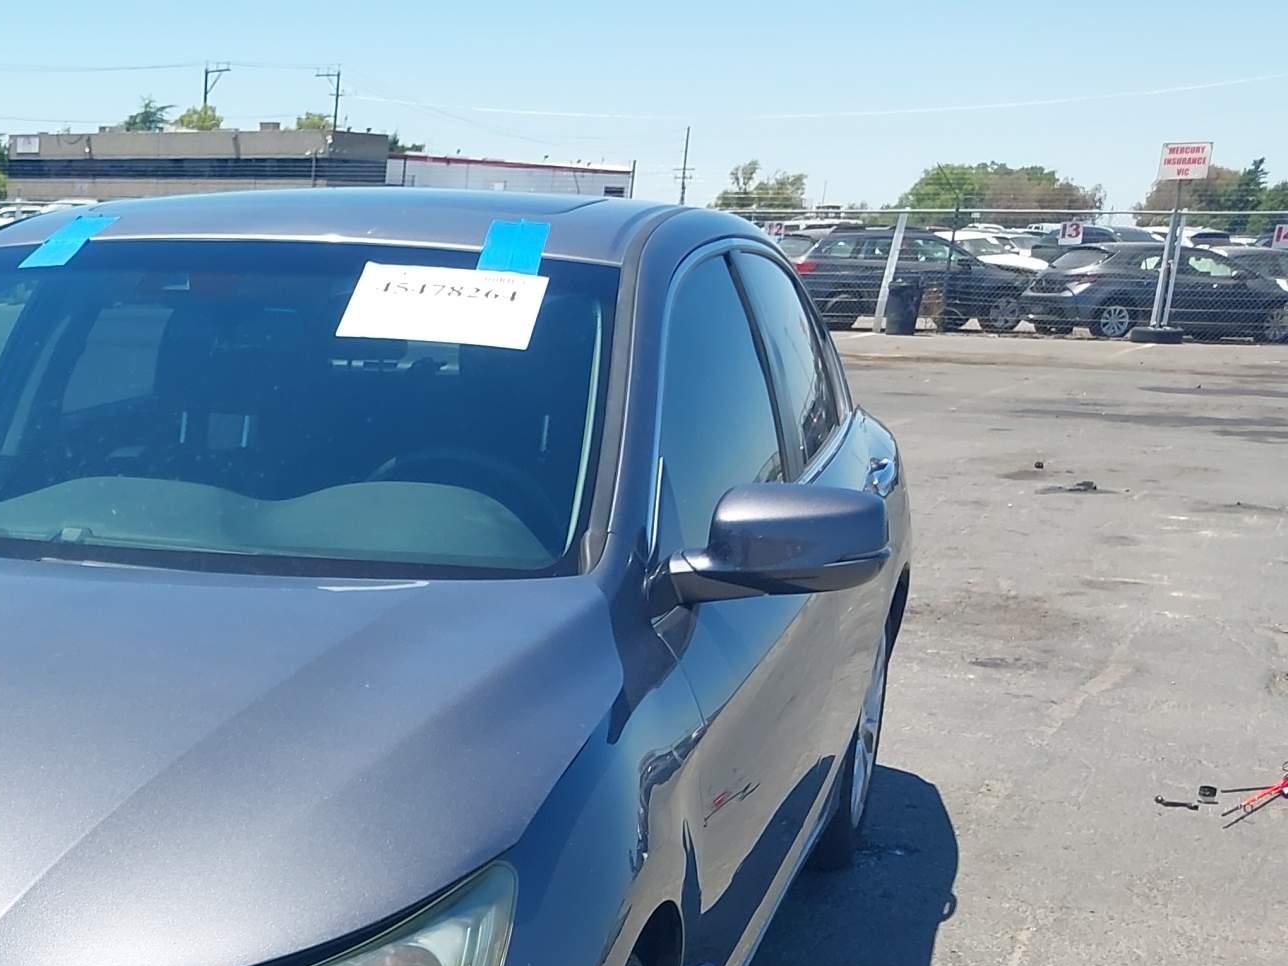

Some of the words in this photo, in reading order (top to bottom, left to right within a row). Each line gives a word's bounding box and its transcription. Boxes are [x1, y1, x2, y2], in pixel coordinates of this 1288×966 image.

[1168, 145, 1206, 154] MERCURY
[1163, 157, 1207, 166] INSURANCE
[1176, 168, 1190, 176] VIC
[1061, 223, 1080, 238] 13
